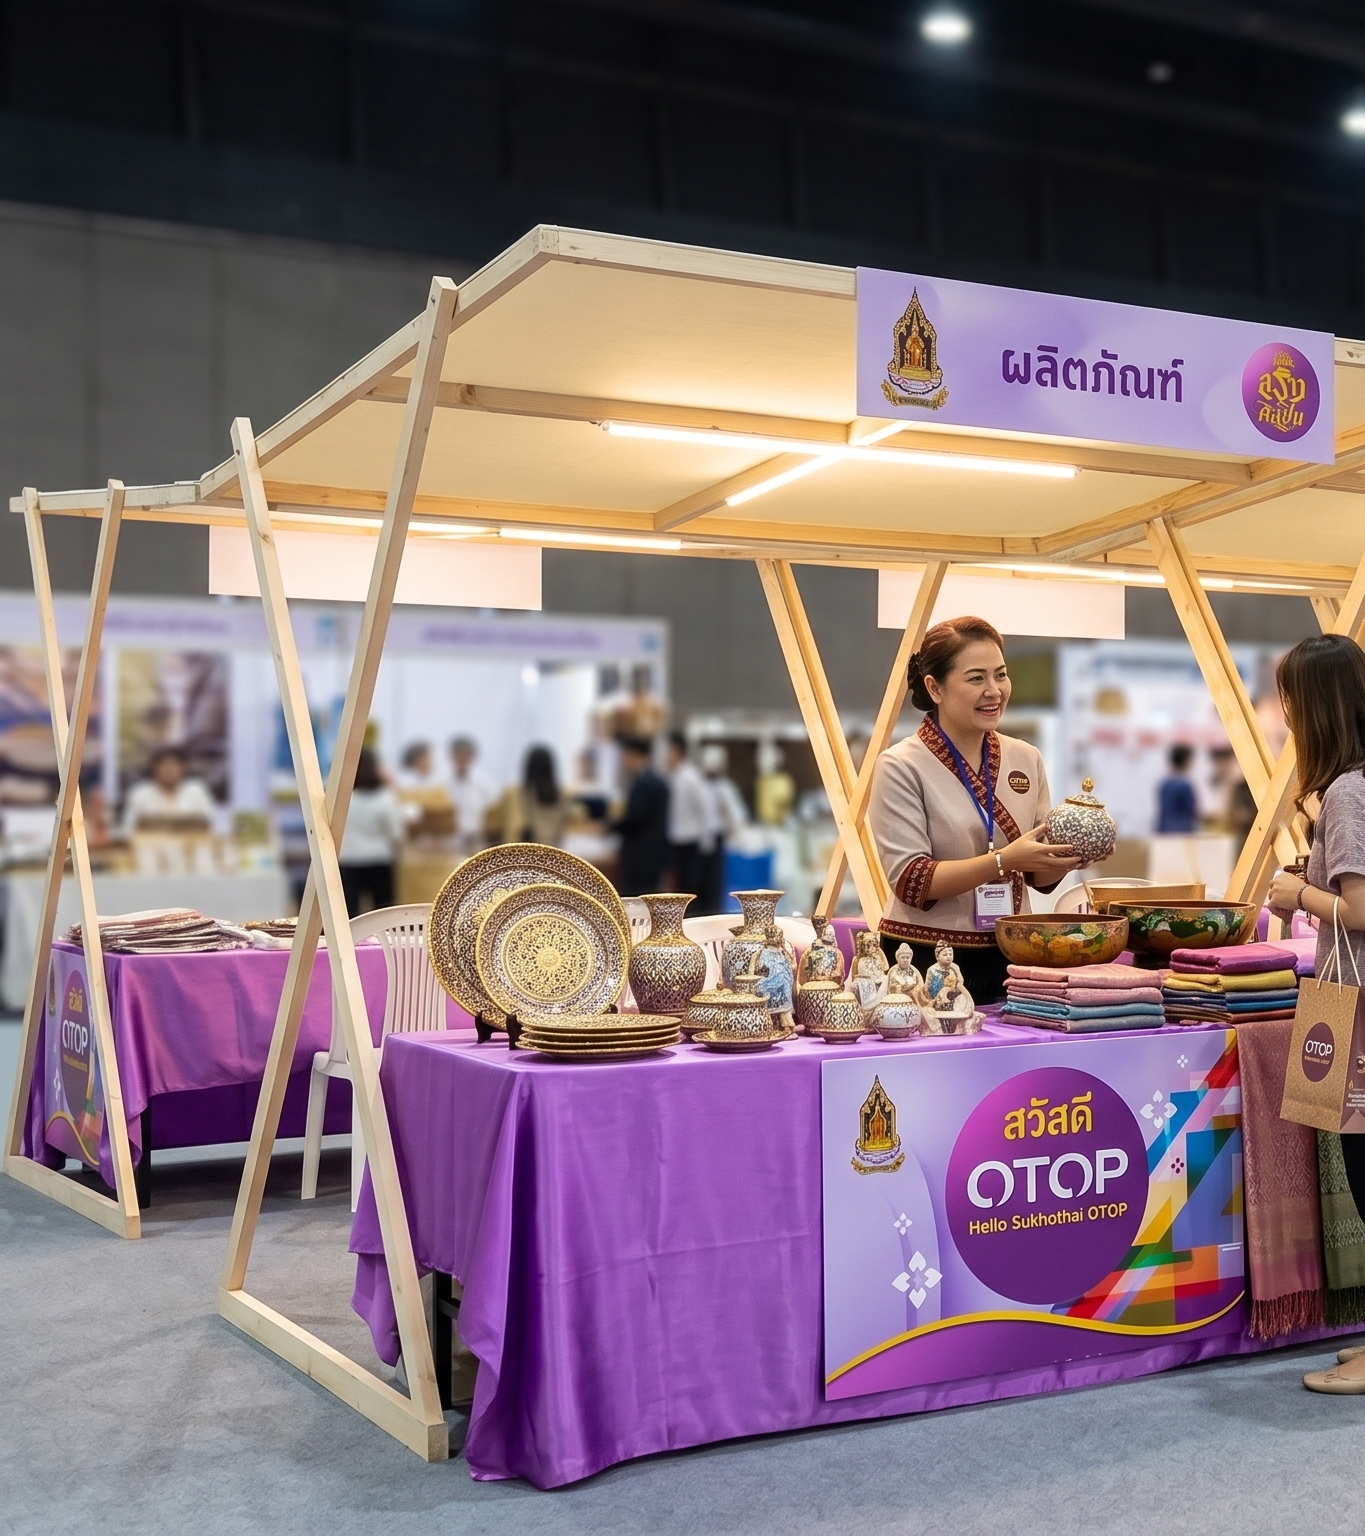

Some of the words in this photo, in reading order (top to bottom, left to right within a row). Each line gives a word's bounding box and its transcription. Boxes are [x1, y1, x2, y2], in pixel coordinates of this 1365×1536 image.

[1002, 344, 1184, 403] ผลิตภัณฑ์
[1305, 1040, 1333, 1056] OTOP
[1003, 1090, 1093, 1140] สวัสดี
[967, 1148, 1129, 1209] OTOP
[969, 1217, 1008, 1235] Hello
[1011, 1207, 1084, 1230] Sukhothai
[1087, 1202, 1128, 1220] OTOP
